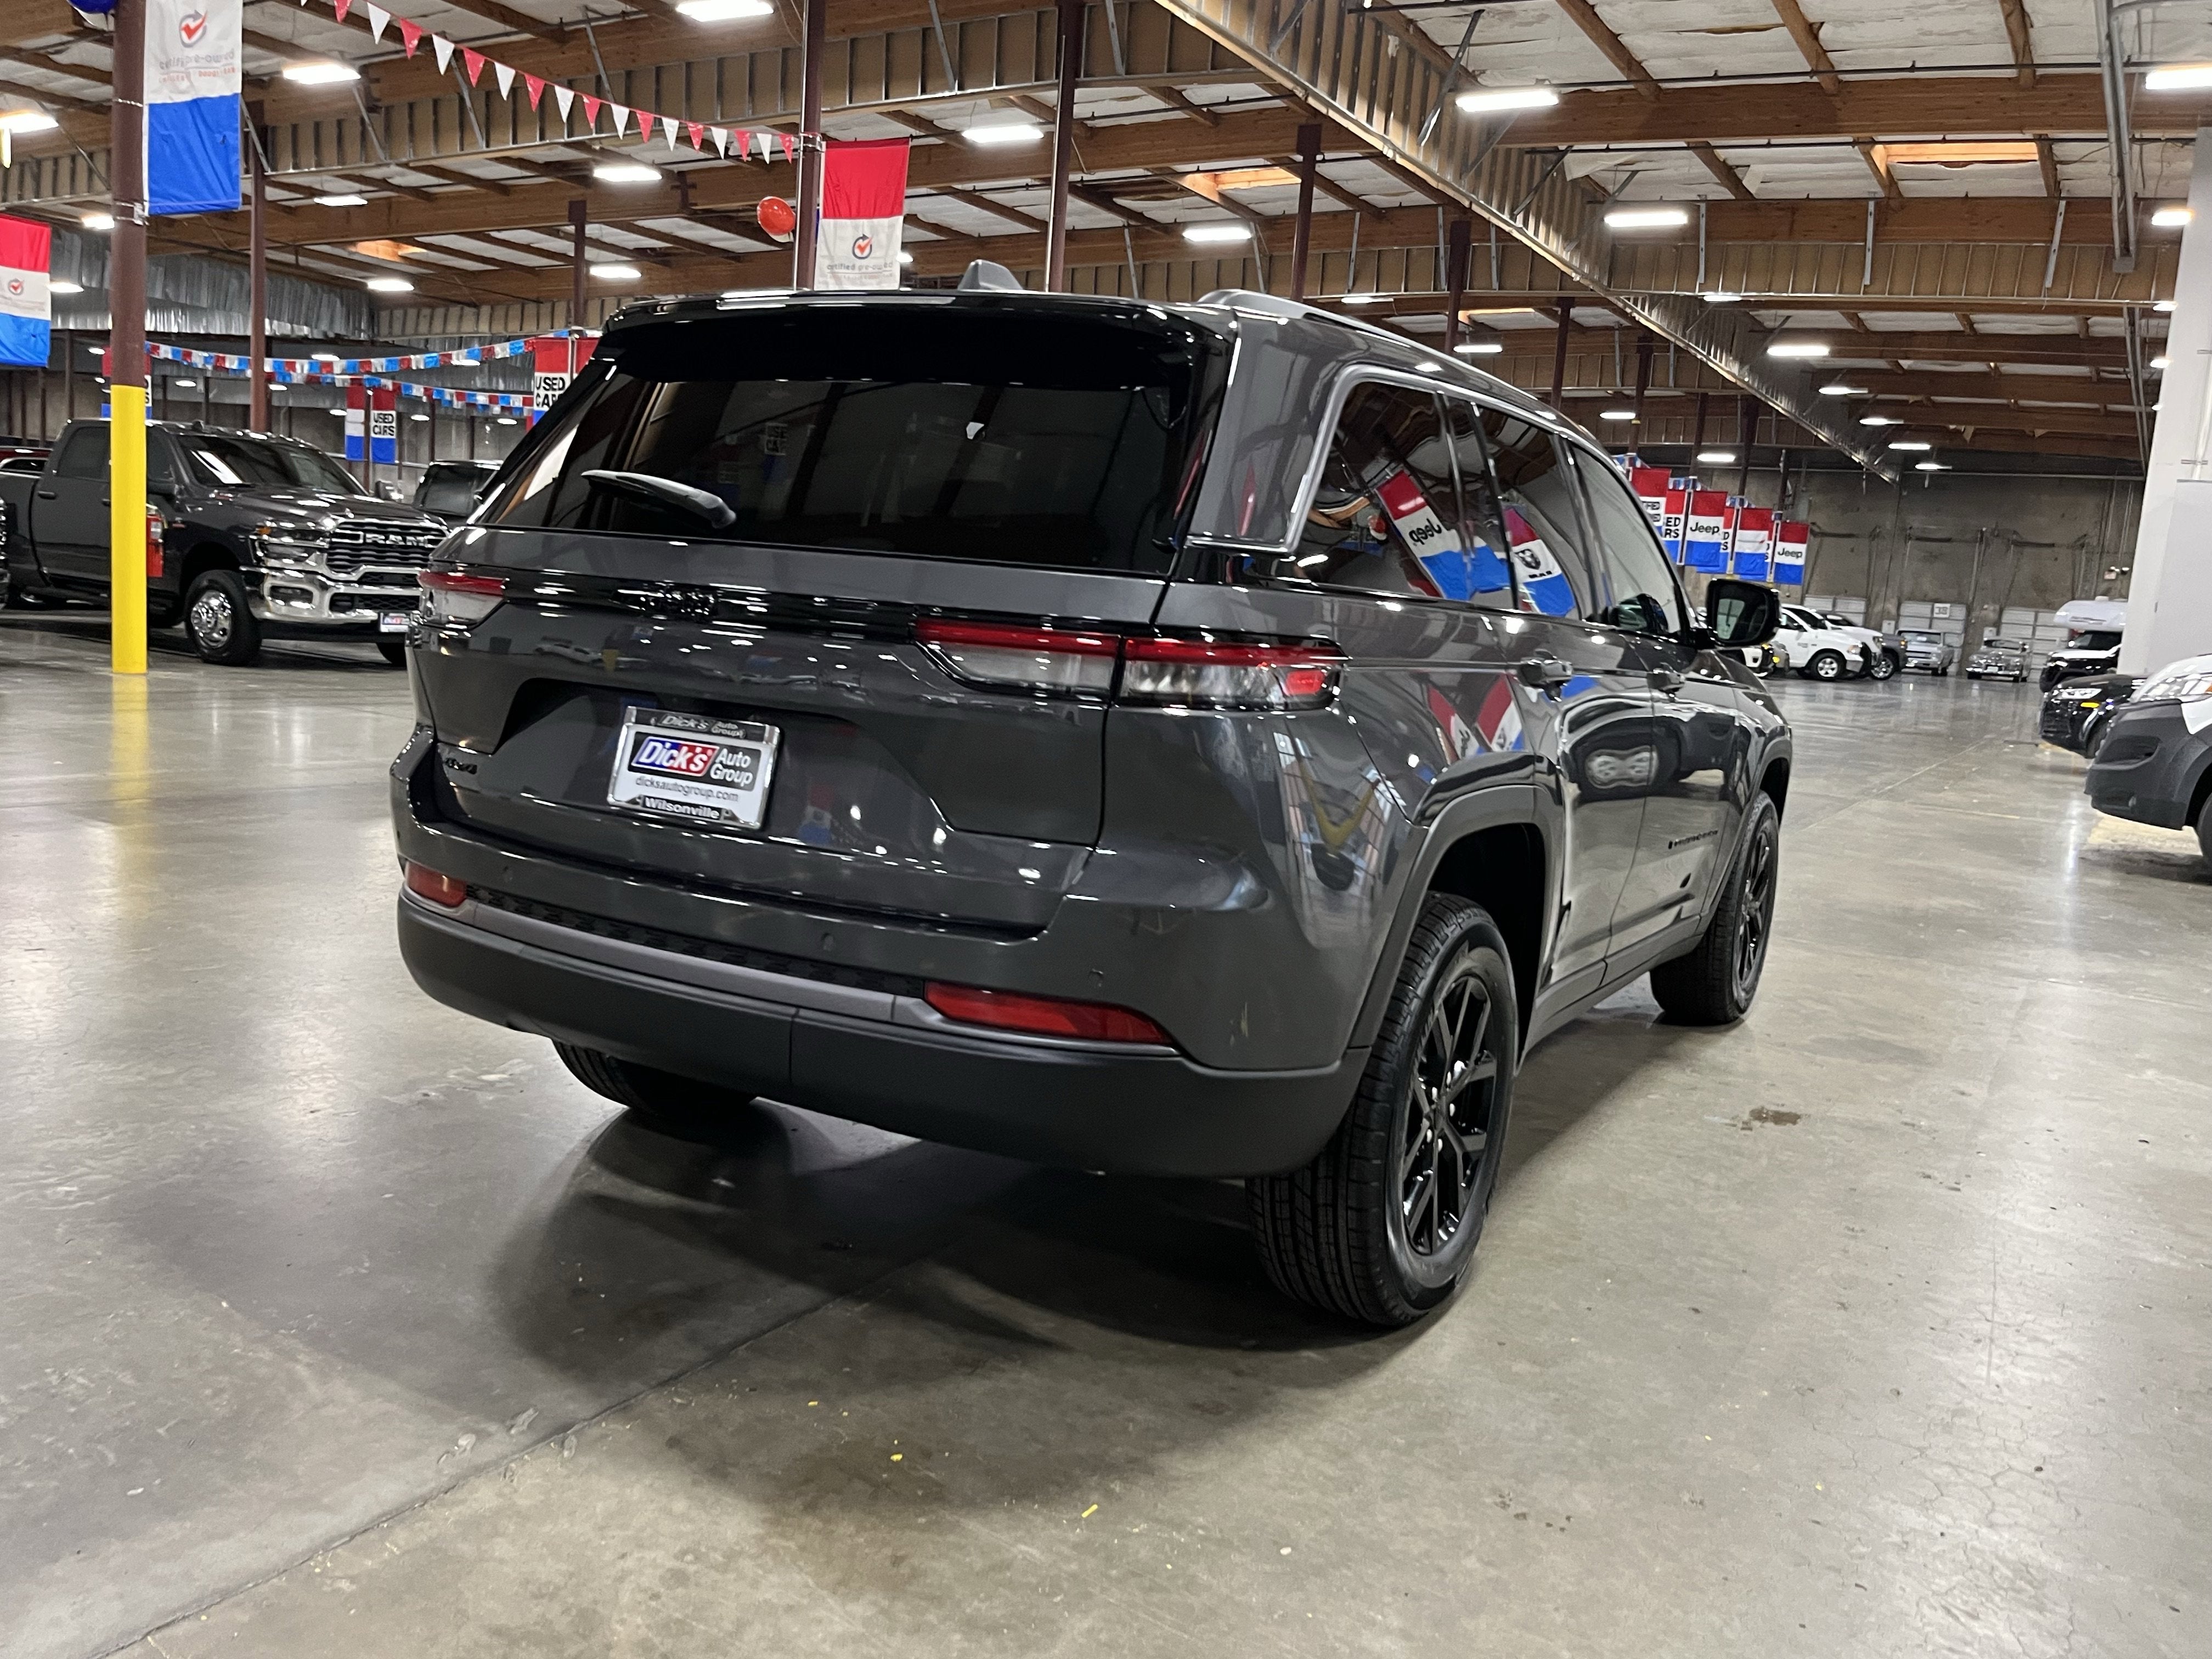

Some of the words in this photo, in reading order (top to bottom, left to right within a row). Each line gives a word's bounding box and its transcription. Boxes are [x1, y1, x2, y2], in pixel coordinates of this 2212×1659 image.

[535, 376, 566, 391] USED
[535, 392, 558, 408] CAR
[1665, 517, 1681, 527] ED
[1690, 522, 1720, 535] Jeep
[365, 533, 426, 546] RAM
[1664, 528, 1679, 538] RS
[1778, 548, 1803, 558] Jeep
[639, 741, 709, 772] Dick's
[715, 748, 751, 768] Auto
[710, 763, 753, 787] Group
[635, 776, 738, 802] dicksautogroup.com
[645, 797, 720, 819] Wilsonville
